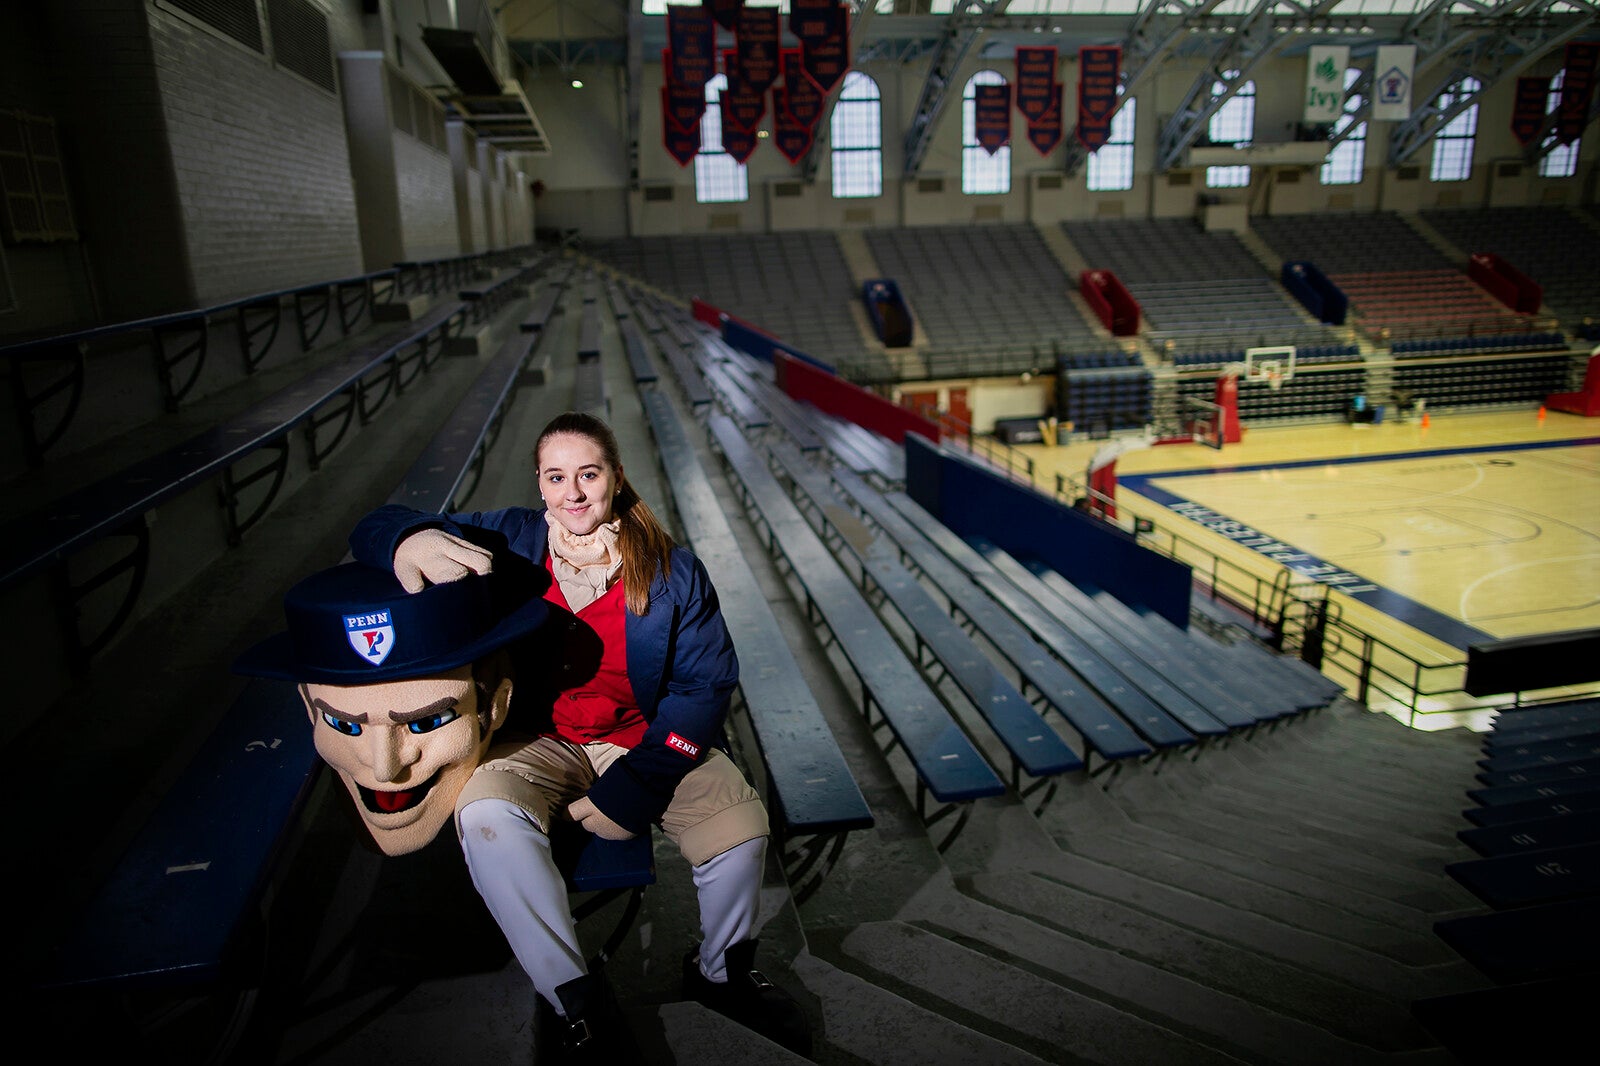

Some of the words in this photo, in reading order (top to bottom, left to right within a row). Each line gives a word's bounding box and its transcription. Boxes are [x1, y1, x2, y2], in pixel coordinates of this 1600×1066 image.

[1309, 86, 1341, 112] Ivy
[347, 613, 388, 628] PENN
[669, 736, 698, 755] PENN
